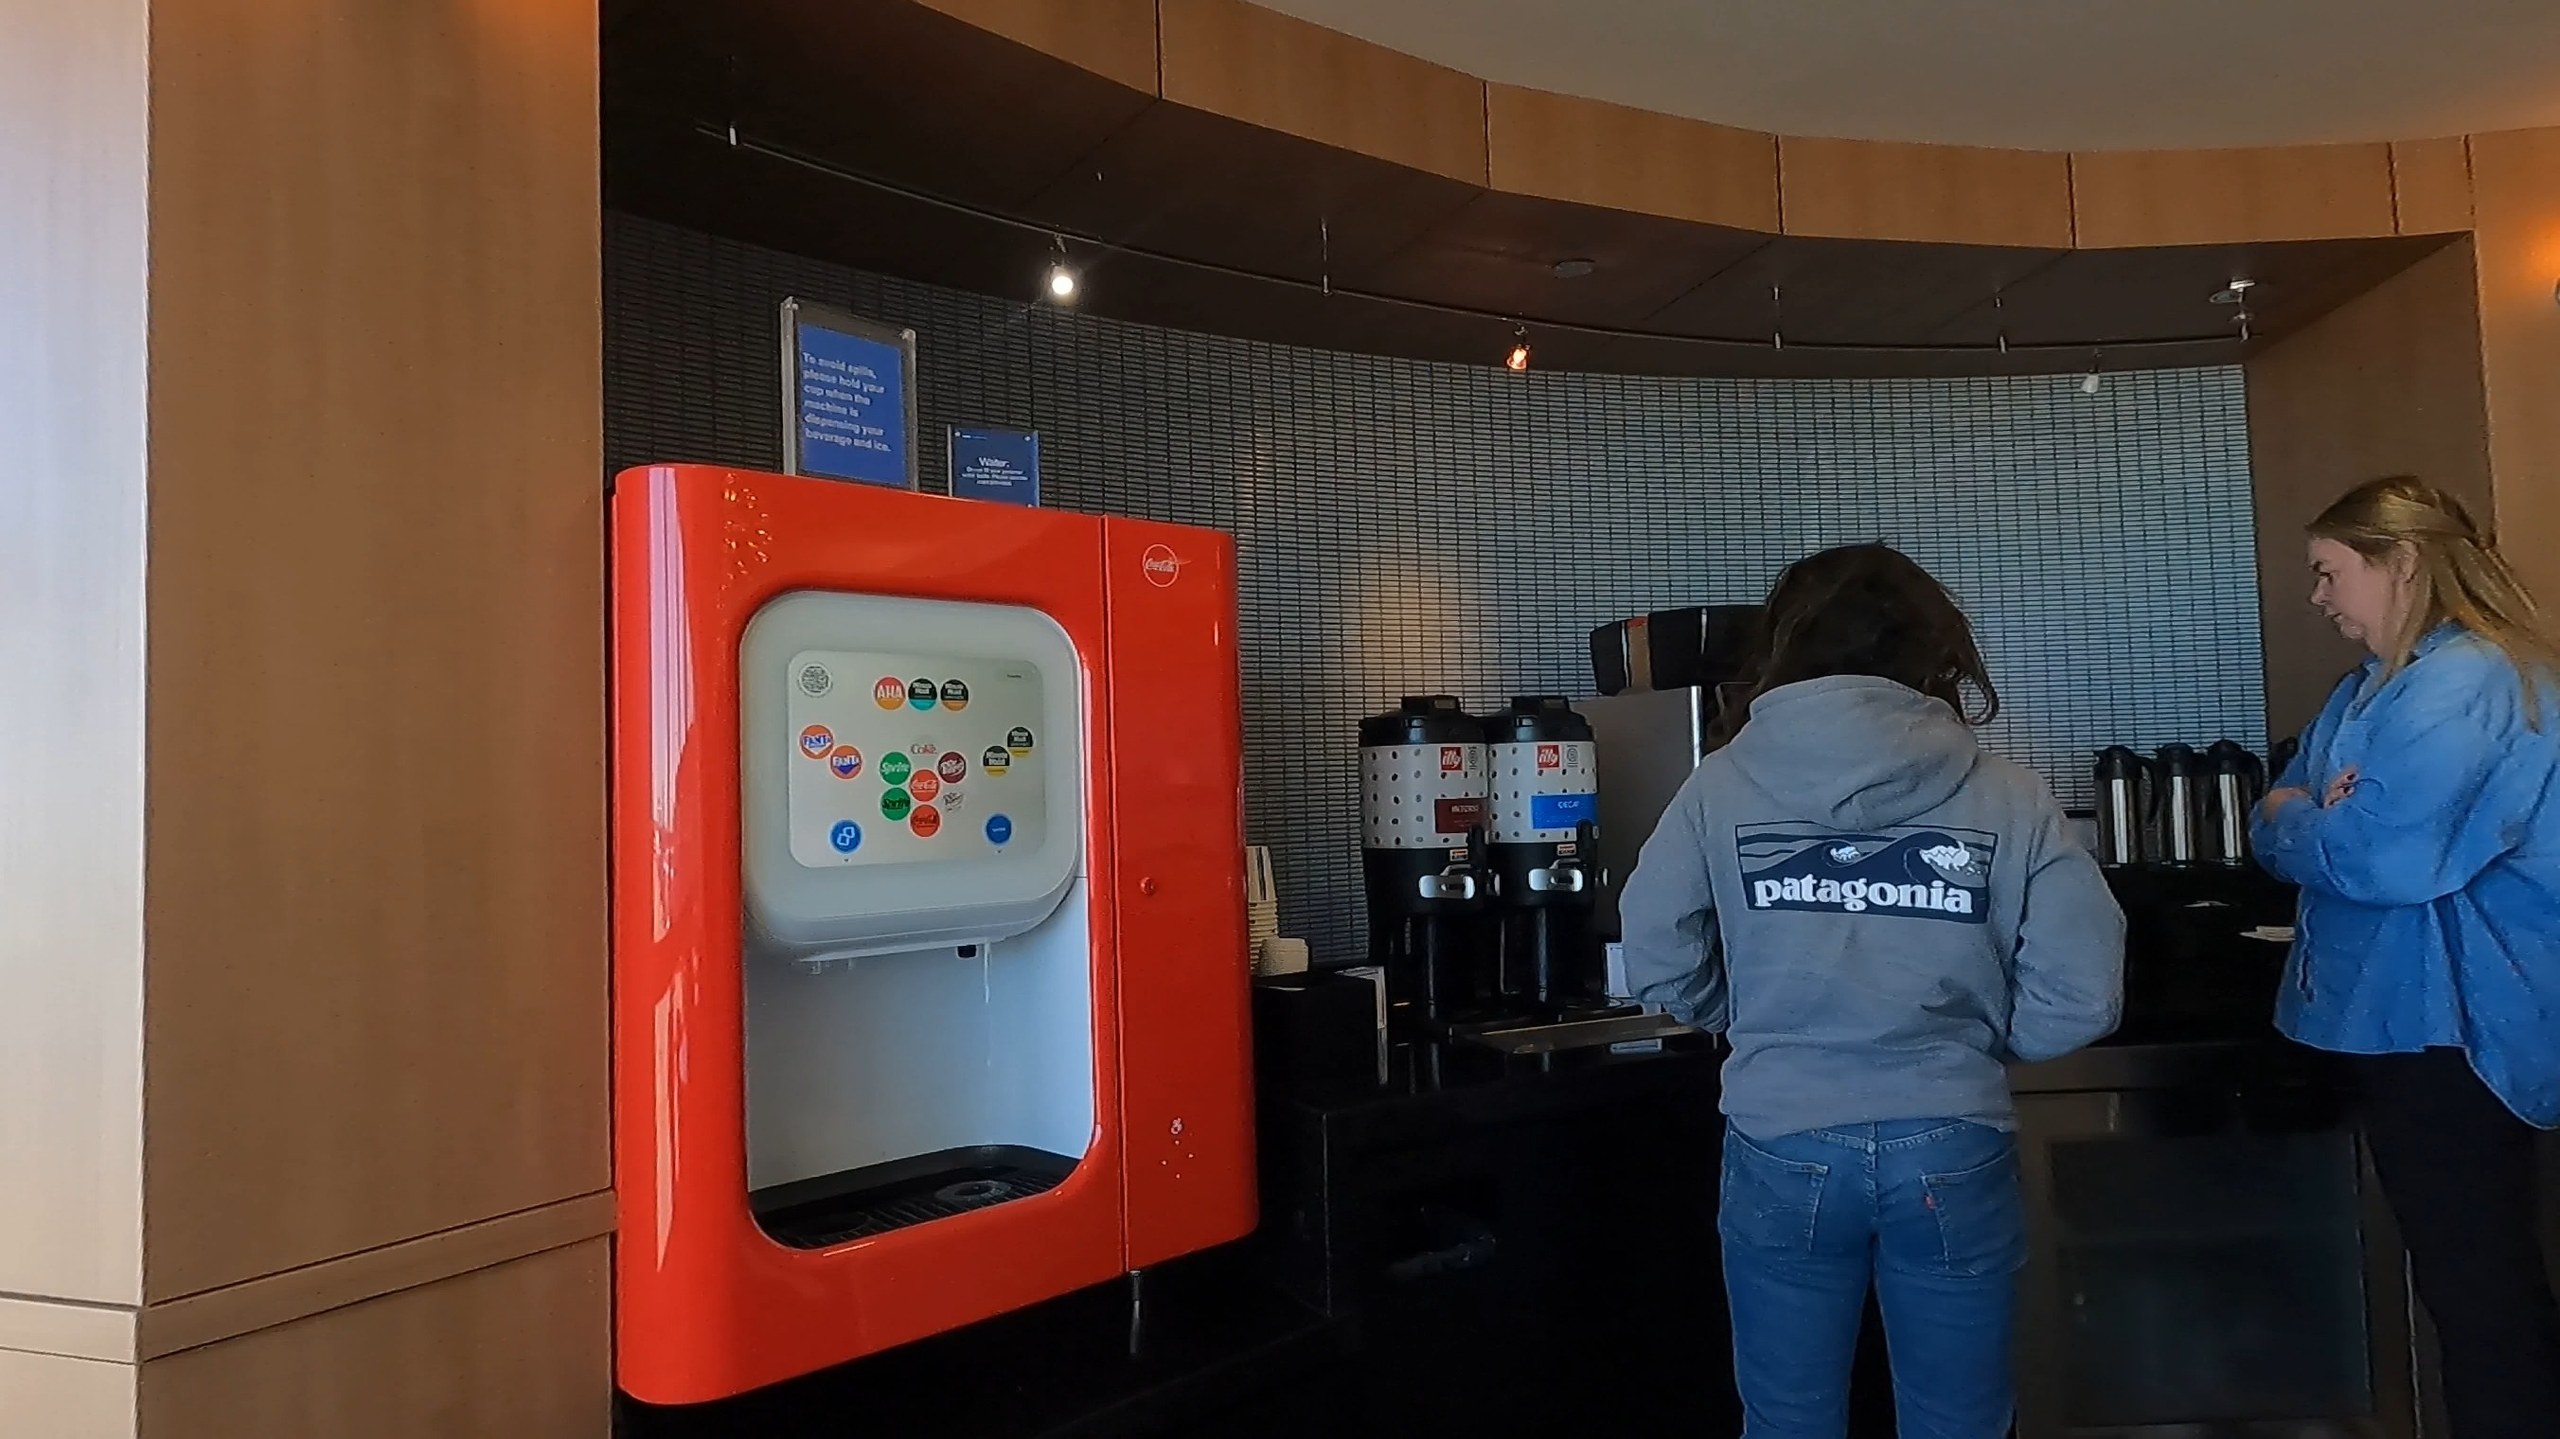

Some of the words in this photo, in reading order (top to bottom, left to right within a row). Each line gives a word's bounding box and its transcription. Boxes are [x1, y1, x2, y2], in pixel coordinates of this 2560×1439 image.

[802, 352, 817, 365] To
[818, 358, 846, 372] avoid
[803, 369, 838, 385] please
[839, 375, 861, 390] hold
[862, 382, 885, 394] your
[803, 384, 824, 397] cup
[825, 388, 853, 401] when
[854, 393, 871, 406] the
[804, 399, 848, 415] machine
[849, 406, 859, 417] is
[804, 413, 861, 434] dispensing
[861, 425, 884, 436] your
[805, 427, 853, 447] beverage
[853, 437, 873, 449] and
[877, 685, 902, 698] AHA
[1442, 750, 1461, 769] illy
[1539, 748, 1558, 766] illy
[881, 761, 909, 775] Sprite
[1753, 873, 1973, 914] patagonia
